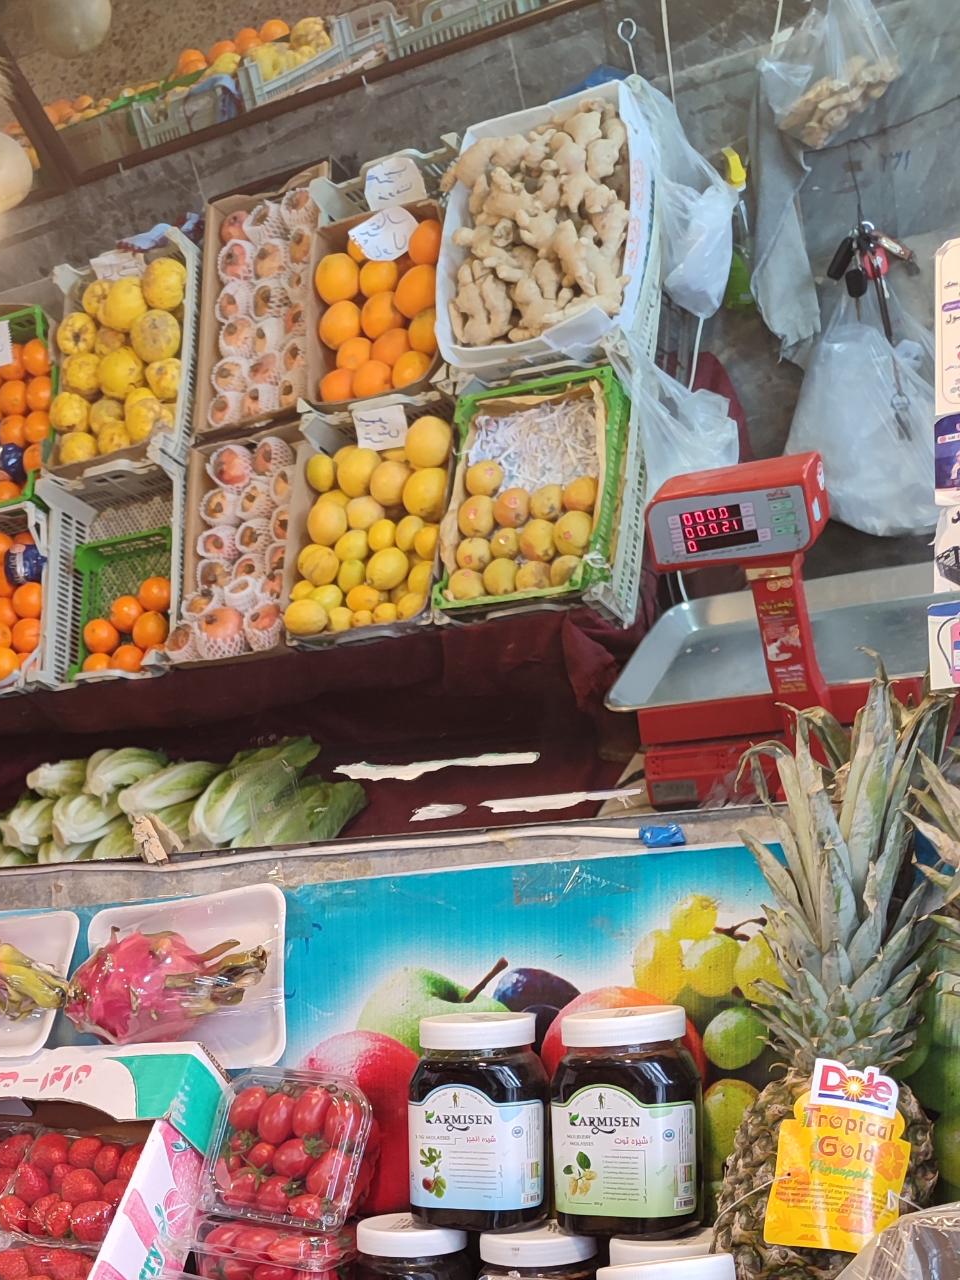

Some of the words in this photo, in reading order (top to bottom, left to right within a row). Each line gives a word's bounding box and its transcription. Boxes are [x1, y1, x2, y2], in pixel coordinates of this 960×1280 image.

[819, 1065, 893, 1102] Dole
[425, 1110, 493, 1131] KARMISEN
[568, 1112, 640, 1134] KARMISEN
[804, 1105, 895, 1141] Tropical
[614, 1137, 628, 1145] توت
[631, 1136, 648, 1146] شیره
[817, 1135, 874, 1162] Gold
